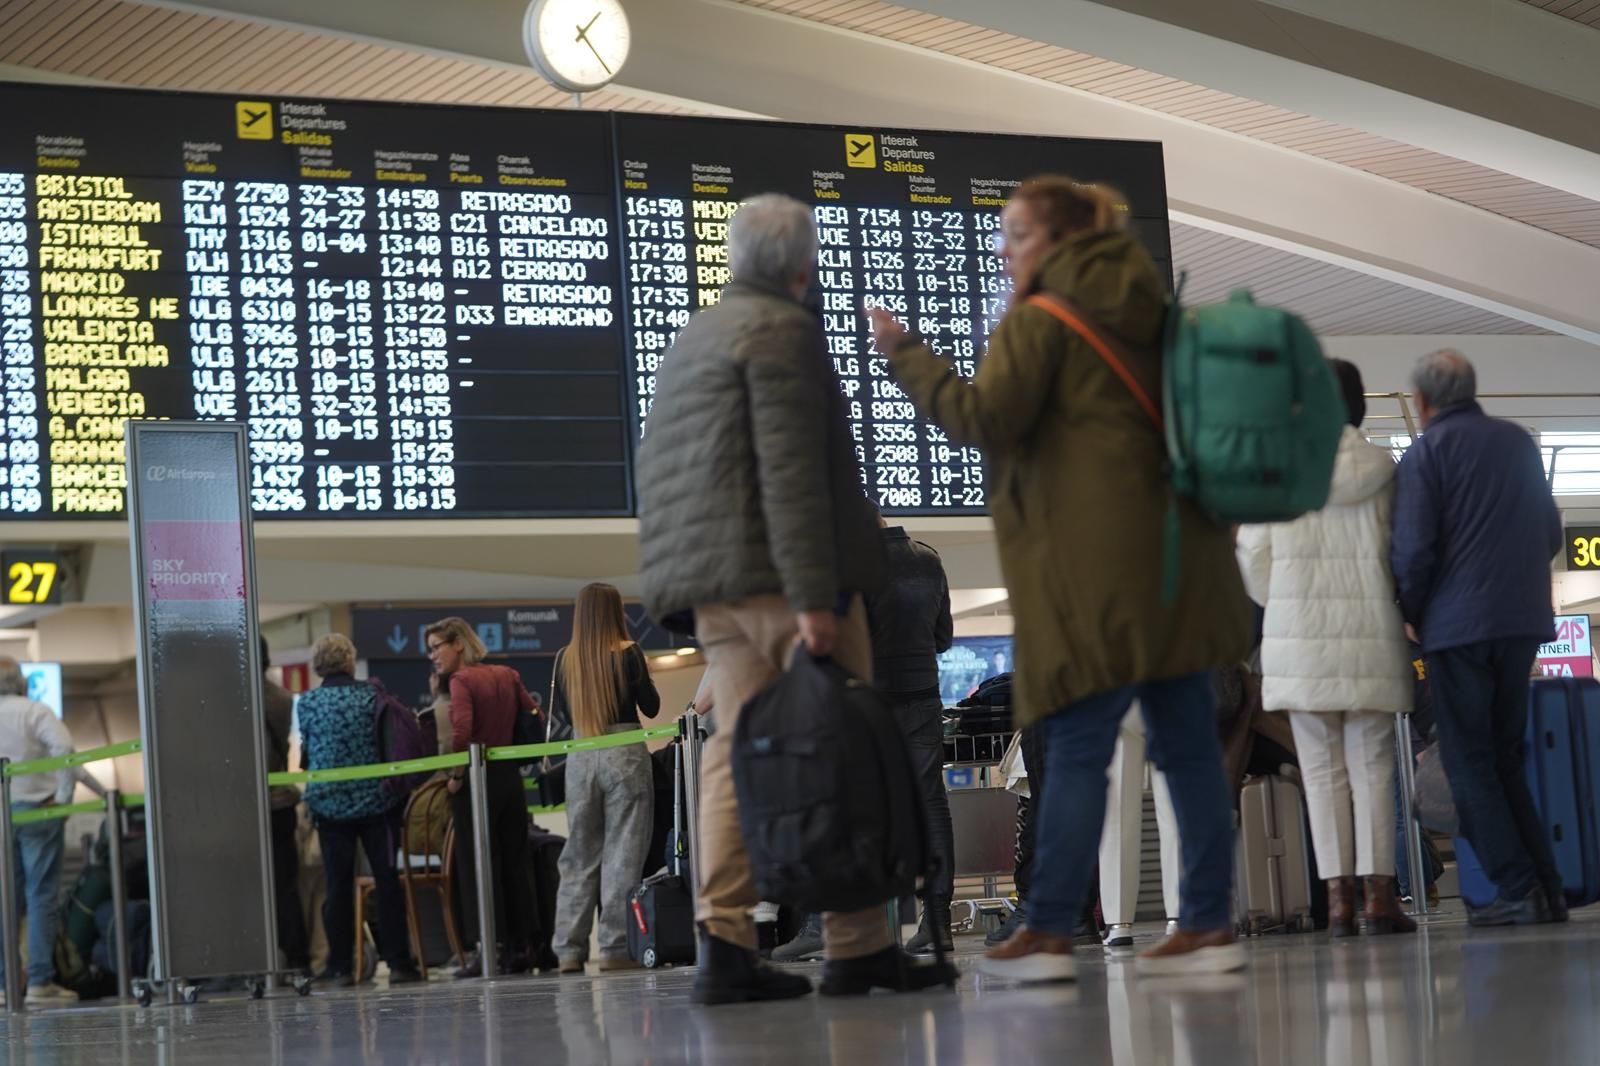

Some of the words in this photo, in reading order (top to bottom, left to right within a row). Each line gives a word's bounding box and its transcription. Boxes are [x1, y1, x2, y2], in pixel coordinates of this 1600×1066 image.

[281, 115, 346, 130] Departures
[282, 131, 332, 146] Salidas
[881, 134, 918, 147] Irteerak
[882, 147, 934, 160] Departures
[625, 170, 644, 178] Time
[884, 160, 924, 174] Salidas
[499, 175, 566, 187] Observaciones
[625, 180, 648, 190] Hora
[693, 173, 734, 184] Destination
[814, 180, 834, 189] Flight
[36, 174, 133, 198] BRISTOL
[182, 180, 224, 201] EZY
[235, 182, 289, 204] 2750
[298, 184, 365, 206] 32-33
[376, 188, 440, 209] 14:50
[461, 191, 571, 214] RETRASADO
[693, 183, 728, 194] Destino
[815, 190, 840, 200] Vuelo
[910, 184, 936, 194] Counter
[972, 187, 1001, 197] Boarding
[910, 194, 952, 204] Mostrador
[972, 196, 1008, 207] Embarqu
[37, 198, 161, 223] AMSTERDAM
[184, 204, 226, 225] KLM
[238, 206, 290, 226] 1524
[300, 208, 366, 229] 24-27
[378, 211, 440, 232] 11:38
[450, 213, 487, 233] C21
[499, 215, 608, 236] CANCELADO
[626, 197, 684, 218] 16:50
[693, 200, 748, 218] MADR
[815, 206, 848, 224] AEA
[857, 208, 901, 226] 7154
[912, 210, 964, 229] 19-22
[40, 223, 148, 247] ISTANBUL
[184, 228, 227, 249] THY
[240, 230, 292, 250] 1316
[302, 232, 368, 253] 01-04
[379, 234, 441, 255] 13:40
[450, 236, 490, 256] B16
[499, 238, 608, 260] RETRASADO
[628, 219, 685, 239] 17:15
[817, 228, 850, 246] VOE
[860, 230, 902, 247] 1349
[912, 231, 965, 250] 32-32
[39, 247, 162, 270] FRANKFURT
[186, 251, 229, 272] DLH
[241, 252, 293, 274] 1143
[380, 257, 442, 278] 12:44
[452, 259, 492, 278] A12
[501, 260, 586, 281] CERRADO
[628, 242, 686, 262] 17:20
[818, 250, 851, 268] KLM
[862, 252, 904, 270] 1526
[914, 253, 966, 272] 23-27
[41, 271, 124, 294] MADRID
[190, 276, 230, 296] IBE
[240, 277, 294, 298] 0434
[307, 278, 370, 300] 16-18
[382, 281, 444, 301] 13:40
[502, 284, 612, 304] RETRASADO
[630, 264, 688, 284] 17:30
[819, 271, 853, 288] VLG
[864, 273, 905, 290] 1431
[916, 274, 968, 293] 10-15
[632, 286, 689, 306] 17:35
[823, 293, 854, 310] IBE
[919, 296, 970, 314] 16-18
[42, 295, 140, 318] LONDRES
[151, 298, 179, 319] HE
[189, 298, 232, 320] VLG
[241, 300, 296, 322] 6310
[308, 302, 372, 323] 10-15
[384, 304, 446, 324] 13:22
[456, 305, 494, 324] D33
[633, 308, 690, 328] 17:40
[824, 314, 856, 332] DLH
[919, 317, 972, 334] 06-08
[44, 320, 154, 342] VALENCIA
[190, 322, 233, 344] VLG
[242, 324, 297, 345] 3966
[308, 325, 373, 346] 10-15
[384, 327, 446, 348] 13:50
[826, 336, 858, 354] IBE
[45, 344, 168, 367] BARCELONA
[191, 346, 234, 368] VLG
[246, 347, 298, 368] 1425
[310, 348, 374, 369] 10-15
[386, 350, 448, 370] 13:55
[46, 368, 130, 391] MALAGA
[192, 370, 236, 392] VLG
[245, 371, 298, 393] 2611
[311, 372, 376, 393] 10-15
[387, 373, 449, 394] 14:00
[47, 392, 145, 414] VENECIA
[194, 394, 236, 416] VOE
[249, 394, 301, 416] 1345
[310, 395, 378, 416] 32-32
[388, 396, 451, 416] 14:55
[872, 402, 915, 419] 8030
[49, 416, 170, 439] G.CAN
[248, 418, 302, 440] 3270
[314, 418, 378, 440] 10-15
[390, 420, 452, 440] 15:15
[872, 424, 916, 441] 3556
[392, 442, 454, 463] 15:25
[874, 445, 918, 462] 2508
[929, 446, 981, 463] 10-15
[252, 465, 304, 487] 1437
[316, 465, 381, 487] 10-15
[392, 466, 454, 486] 15:30
[876, 467, 920, 485] 2702
[931, 467, 983, 484] 10-15
[52, 489, 123, 512] PRAGA
[318, 489, 382, 511] 10-15
[394, 488, 456, 510] 16:15
[877, 488, 921, 506] 7008
[931, 488, 984, 506] 21-22
[152, 560, 184, 571] SKY
[8, 562, 56, 602] 27
[154, 572, 227, 584] PRIORITY
